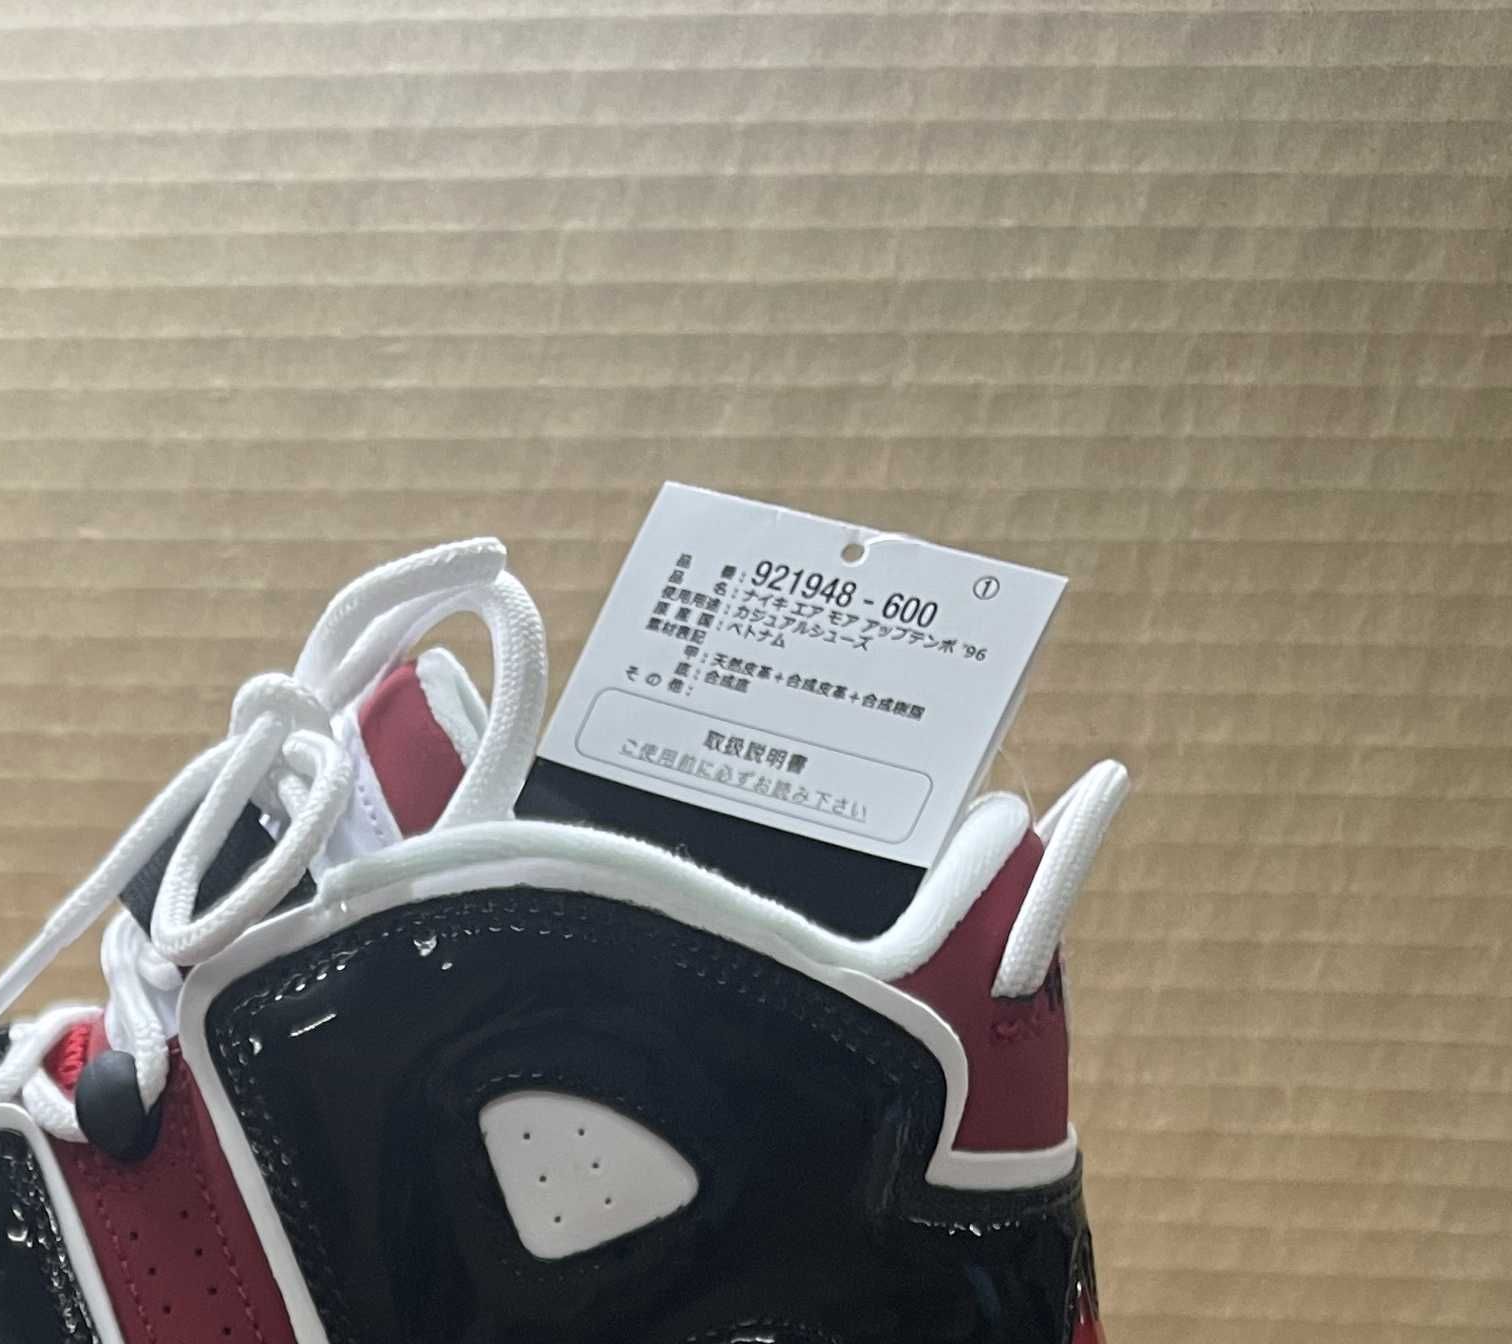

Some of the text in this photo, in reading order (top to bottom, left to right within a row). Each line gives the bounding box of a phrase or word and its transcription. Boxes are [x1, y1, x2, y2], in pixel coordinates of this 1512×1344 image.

[751, 560, 857, 608] 921948
[882, 593, 938, 628] 600
[703, 729, 808, 774] 取扱説明書
